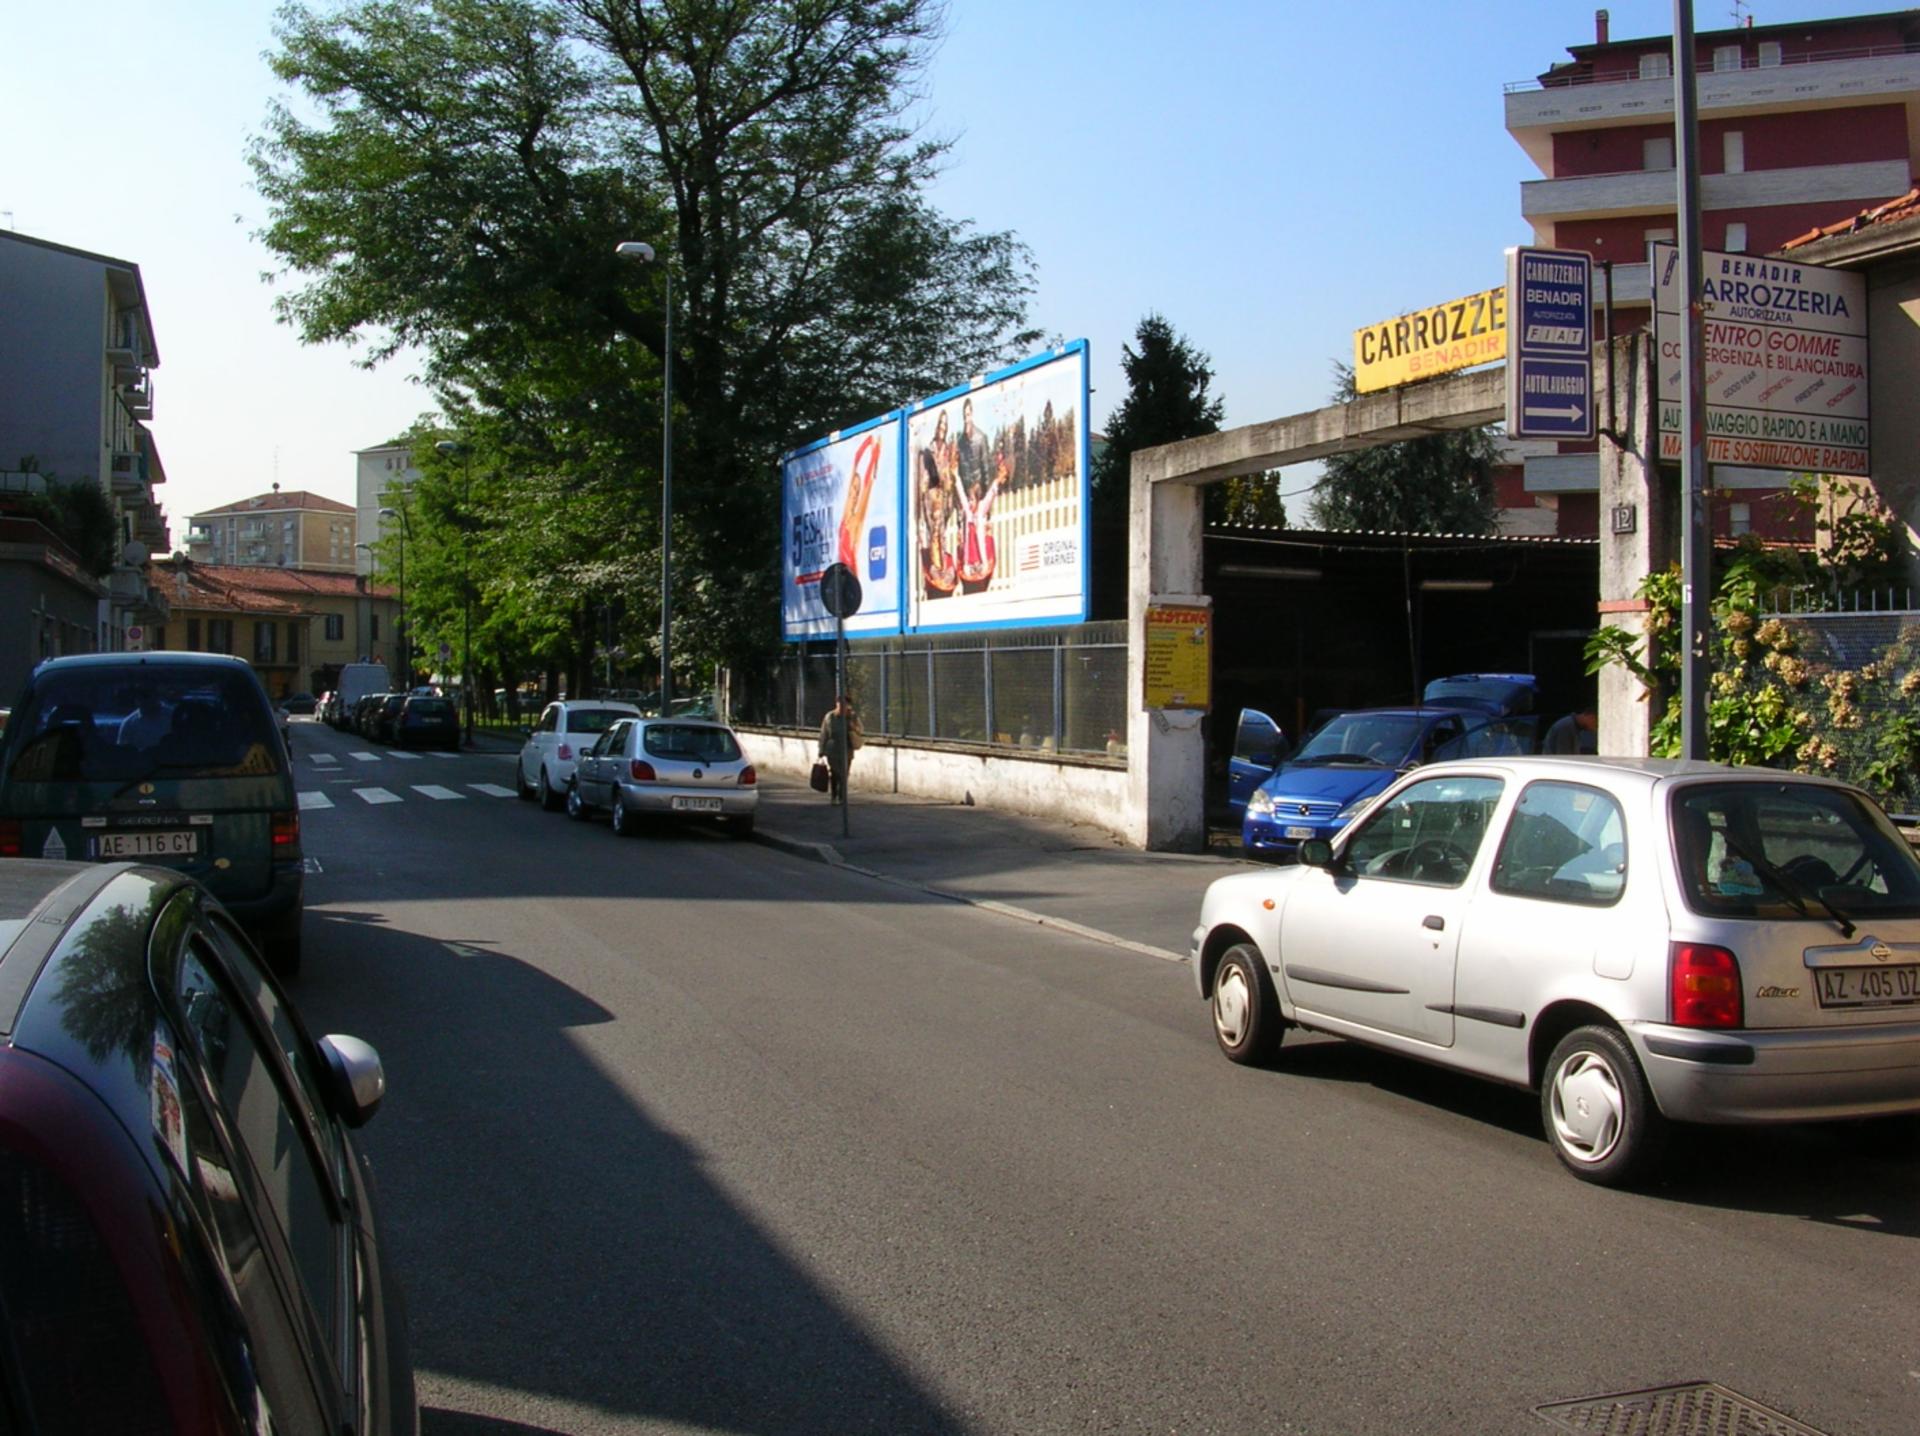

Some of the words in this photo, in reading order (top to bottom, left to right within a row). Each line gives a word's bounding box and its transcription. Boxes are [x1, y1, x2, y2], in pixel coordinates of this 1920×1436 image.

[1525, 261, 1584, 285] CARROZZERIA
[1720, 258, 1802, 284] BENADIR
[1526, 288, 1583, 306] BENADIR
[1703, 277, 1850, 319] ARROZZERIA
[1361, 290, 1505, 366] CARROZZE
[1729, 306, 1794, 324] AUTORIZZATA
[1529, 327, 1581, 343] FIAT
[1704, 323, 1762, 348] ENTRO
[1767, 330, 1841, 357] GOMME
[1409, 335, 1500, 372] BENADIR
[1661, 341, 1764, 369] COERGENZA
[1766, 354, 1774, 369] E
[1777, 354, 1865, 380] BILANCIATURA
[1524, 374, 1585, 396] AUTOLAVAGGIO
[1662, 408, 1760, 435] AUTVAGGIO
[1762, 416, 1806, 439] RAPIDO
[1809, 421, 1816, 440] E
[1818, 422, 1828, 441] A
[1829, 422, 1866, 445] MANO
[1663, 435, 1730, 460] MAITTE
[1733, 441, 1820, 467] SOSTITUZIONE
[1822, 448, 1866, 471] RAPIDA
[1615, 508, 1630, 529] 12
[791, 514, 802, 567] 5
[1043, 539, 1077, 554] ORIGINAL
[1043, 551, 1075, 567] MARINES
[103, 836, 124, 856] AE
[135, 835, 166, 853] 116
[172, 833, 193, 851] GY
[1825, 972, 1849, 999] AZ
[1860, 970, 1893, 997] 405
